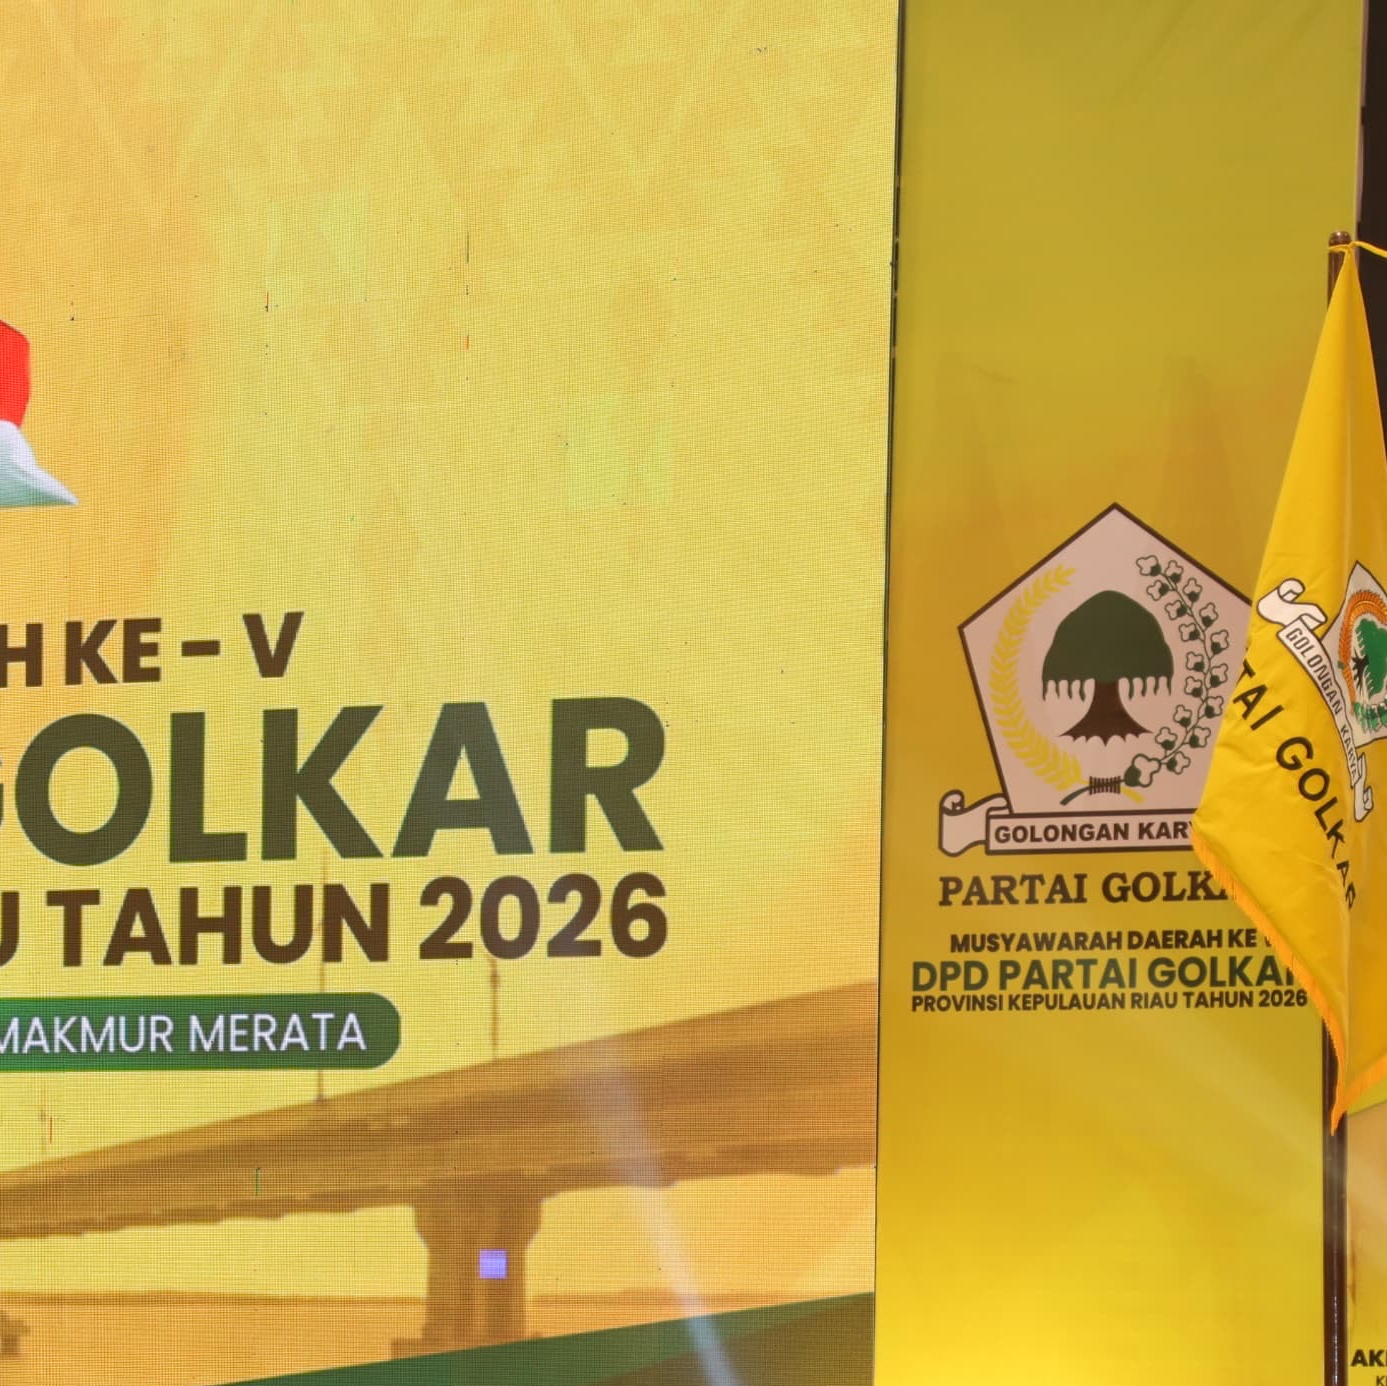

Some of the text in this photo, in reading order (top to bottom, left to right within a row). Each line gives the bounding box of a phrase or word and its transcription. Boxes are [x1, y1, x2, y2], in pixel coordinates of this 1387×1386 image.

[64, 617, 162, 686] KE
[242, 611, 305, 679] V
[1285, 627, 1342, 714] GOLONGAN
[994, 821, 1193, 844] GOLONGAN KAR
[1276, 736, 1356, 909] GOLKAR
[938, 871, 1229, 907] PARTAI GOLK
[45, 882, 391, 968] TAHUN
[419, 871, 669, 960] 2026
[950, 931, 1123, 953] MUSYAWARAH
[1127, 929, 1223, 949] DAERAH
[1228, 928, 1257, 948] KE
[912, 961, 989, 992] DPD
[999, 957, 1137, 991] PARTAI
[911, 989, 1308, 1013] PROVINSI KEPULAUAN RIAU TAHUN 2026
[189, 1012, 367, 1052] MERATA
